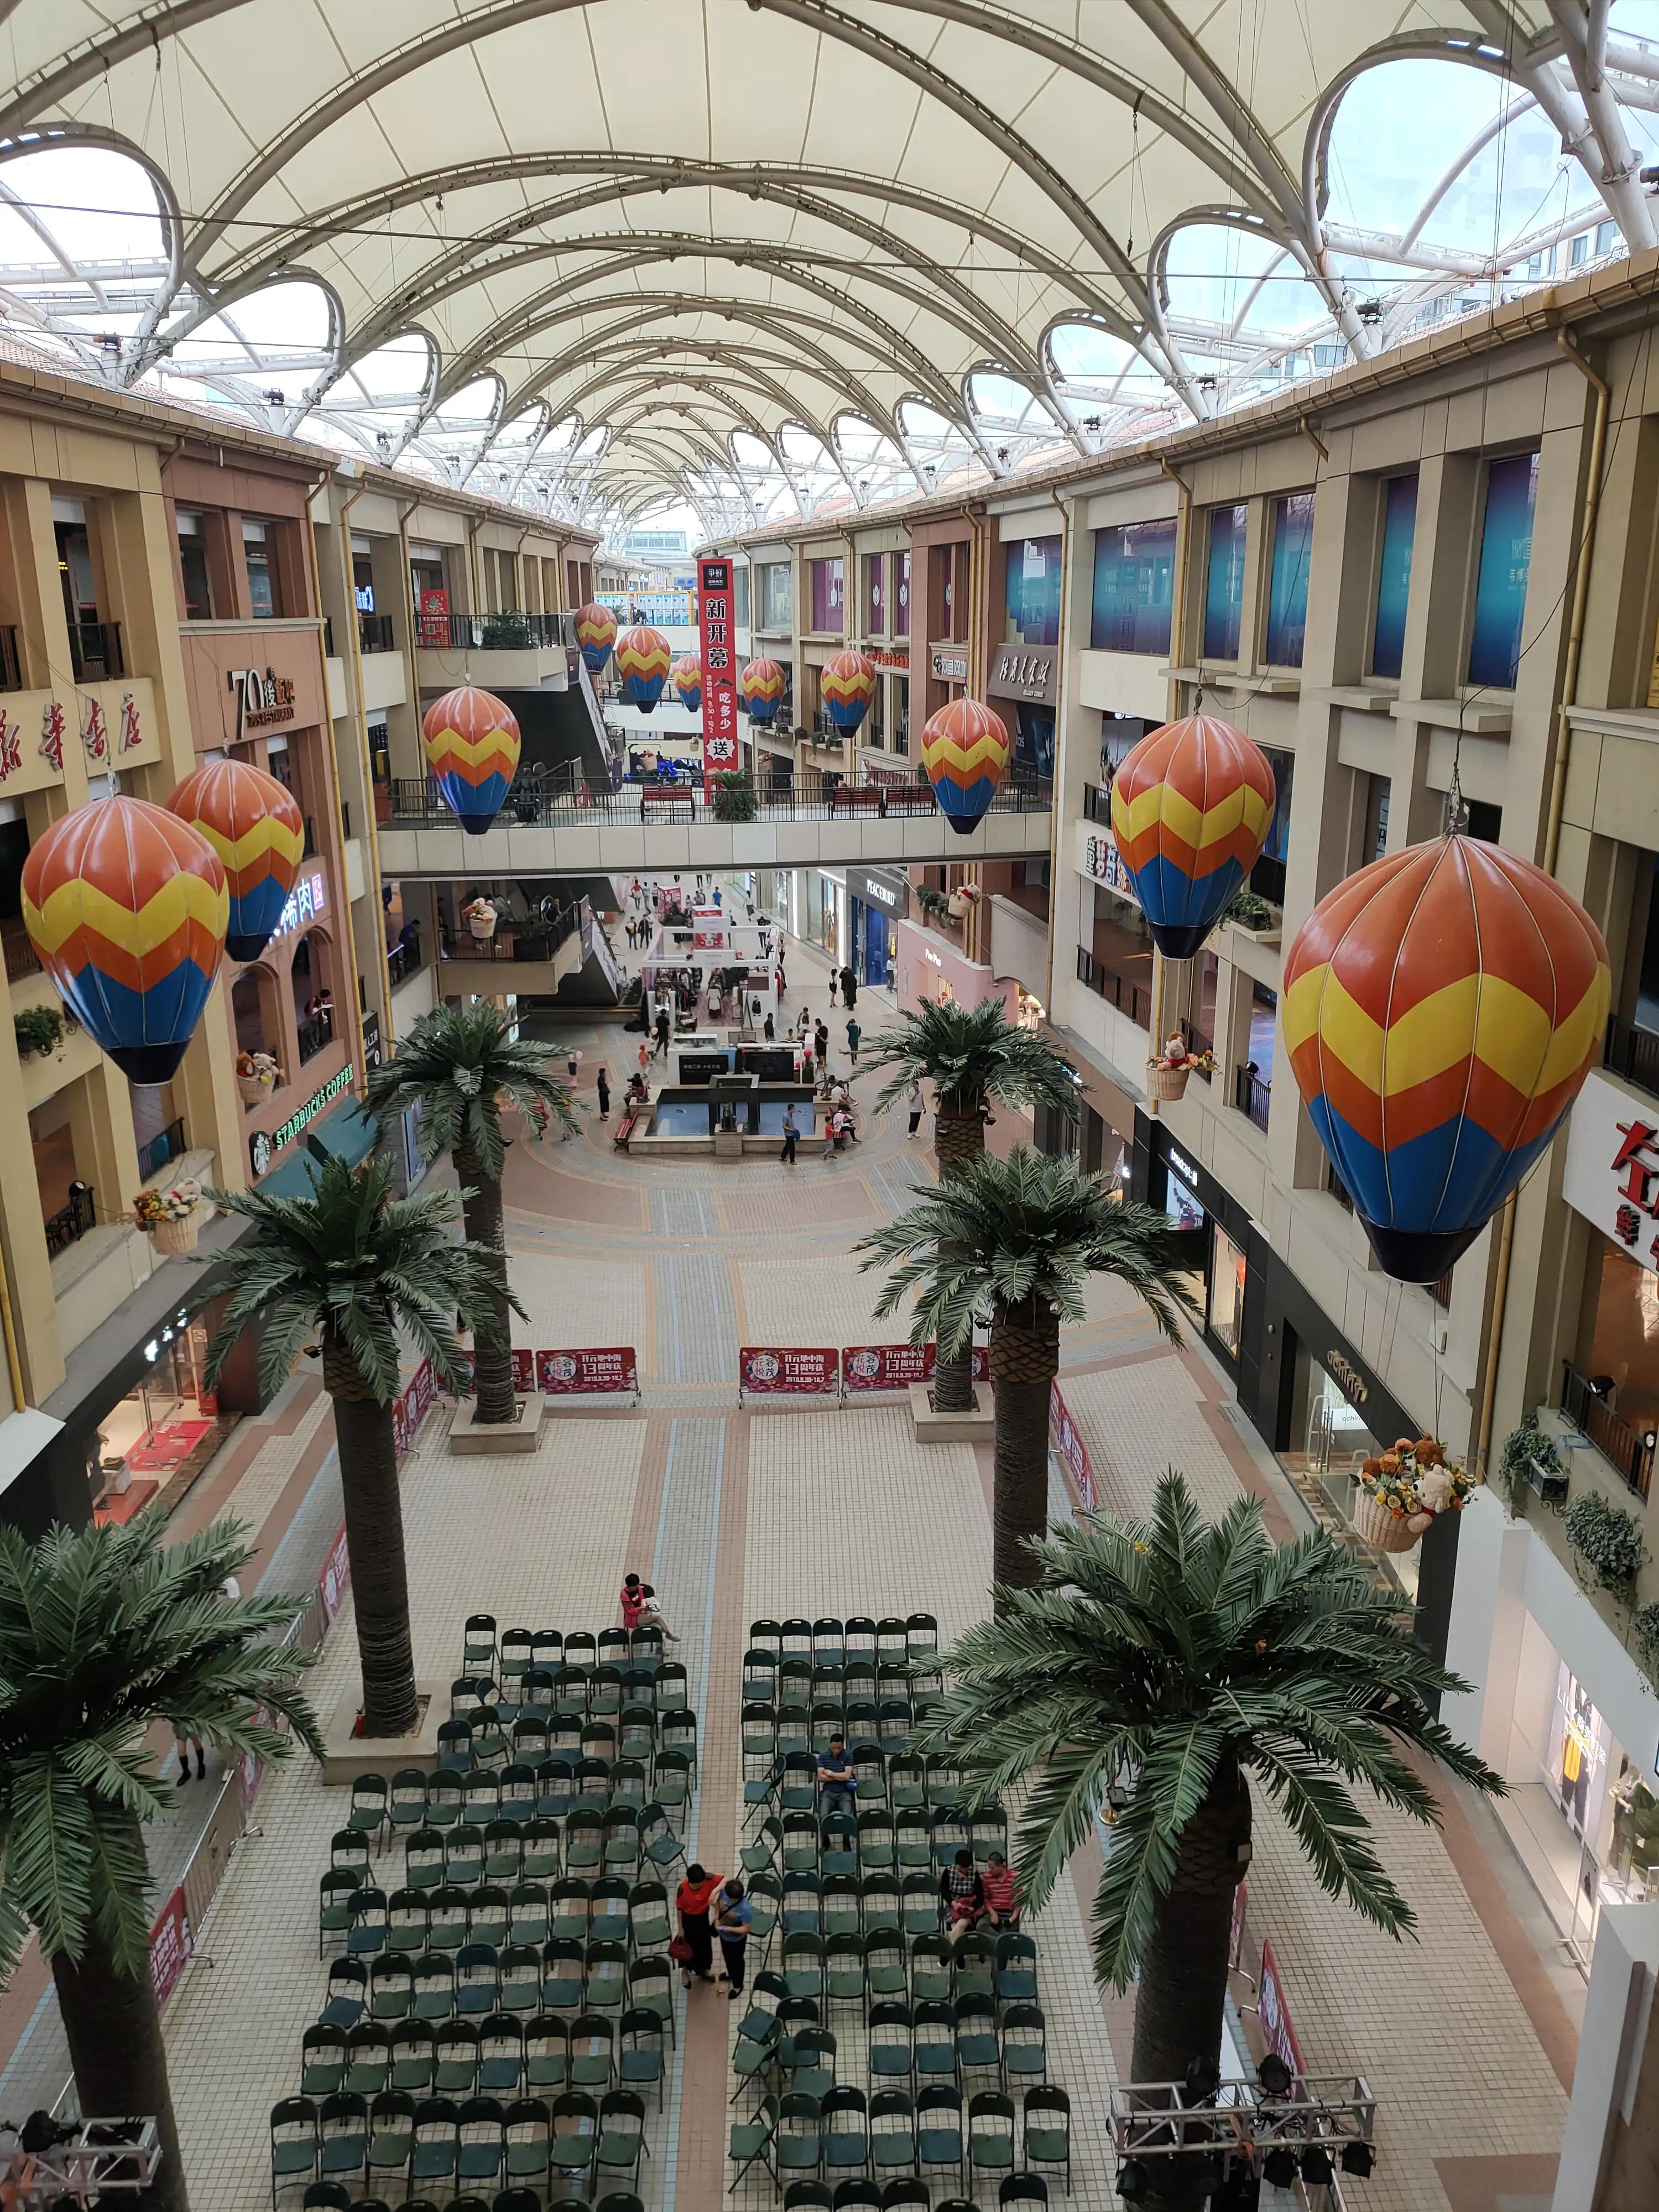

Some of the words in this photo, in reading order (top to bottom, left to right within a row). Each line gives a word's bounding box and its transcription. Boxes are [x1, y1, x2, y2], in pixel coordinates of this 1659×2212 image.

[706, 598, 728, 668] 新开幕
[719, 692, 732, 730] 吃多少
[713, 742, 728, 756] 送
[867, 879, 895, 906] PEACEBIRD
[276, 1089, 326, 1151] STARBUCKS
[326, 1063, 353, 1102] COFFEE
[1327, 1350, 1368, 1403] ochirly
[1557, 1684, 1578, 1719] LILY
